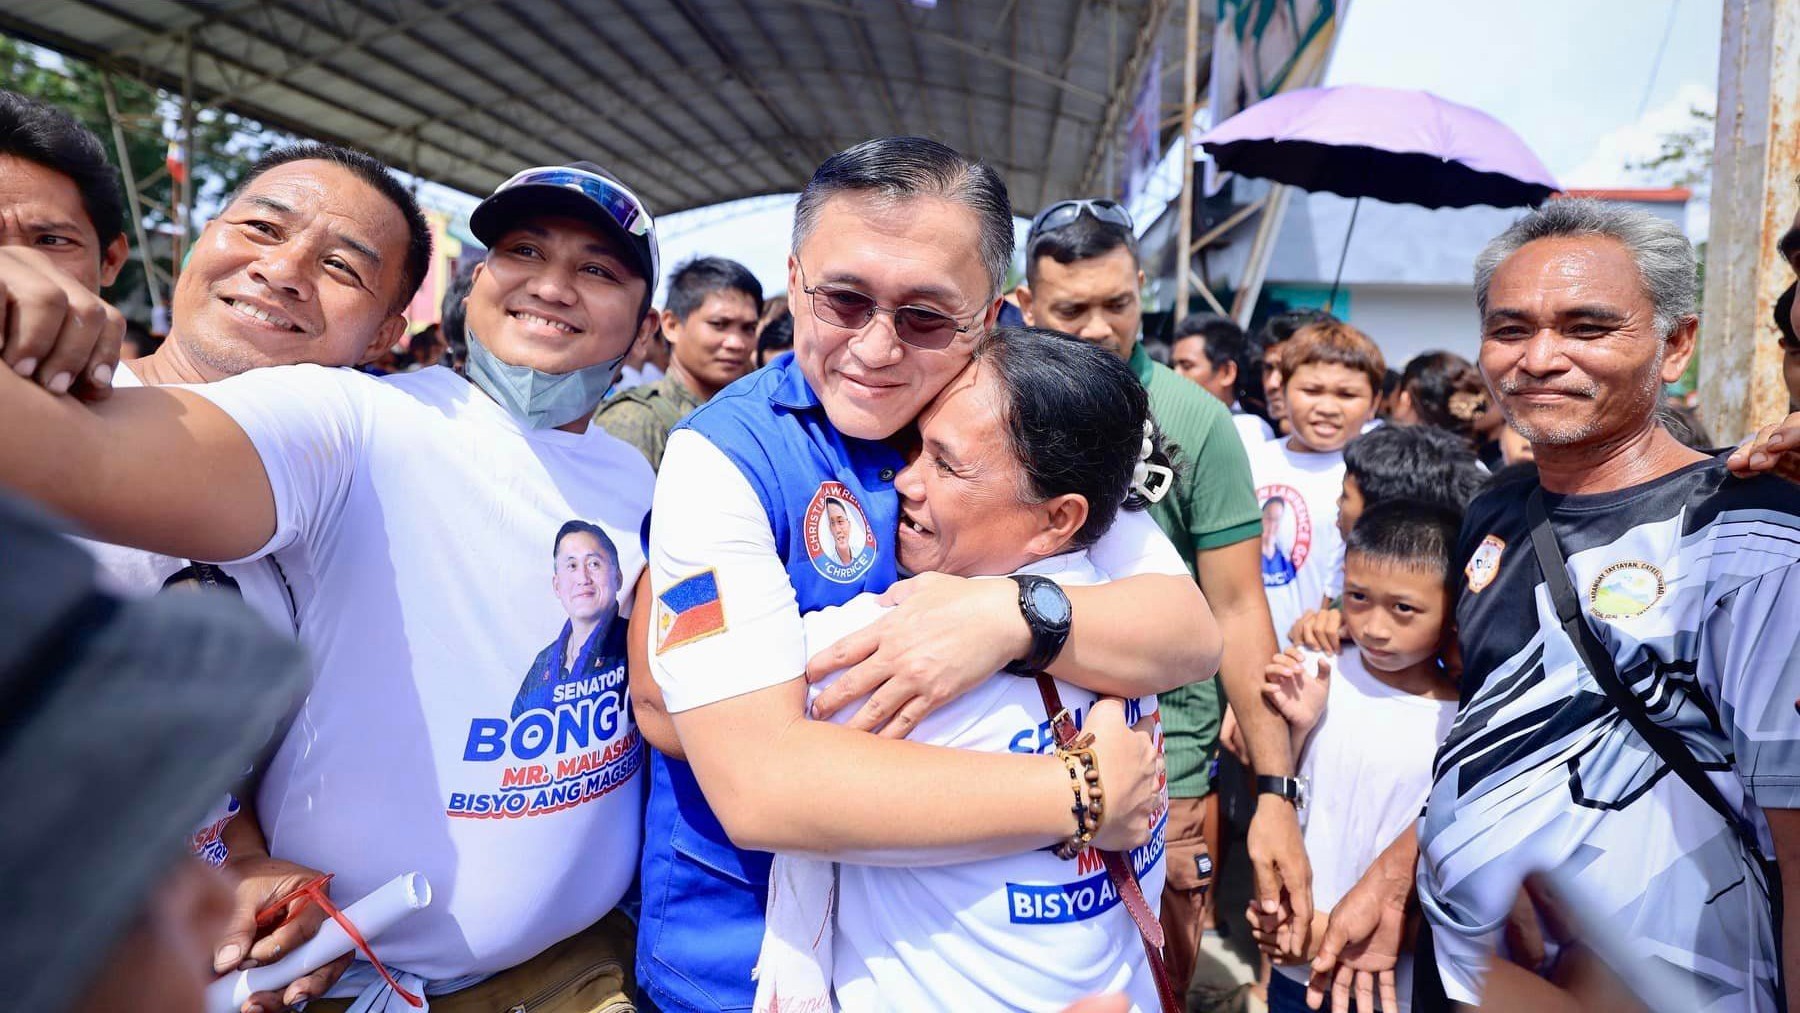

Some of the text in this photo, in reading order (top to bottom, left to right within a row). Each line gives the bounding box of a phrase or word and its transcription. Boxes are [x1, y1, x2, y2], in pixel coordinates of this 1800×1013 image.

[809, 497, 826, 552] CHRISTIA
[553, 666, 625, 703] SENATOR
[463, 695, 619, 762] BONG
[502, 765, 550, 787] MR.
[449, 792, 526, 813] BISYO
[531, 783, 581, 809] ANG
[1012, 887, 1095, 918] BISYO
